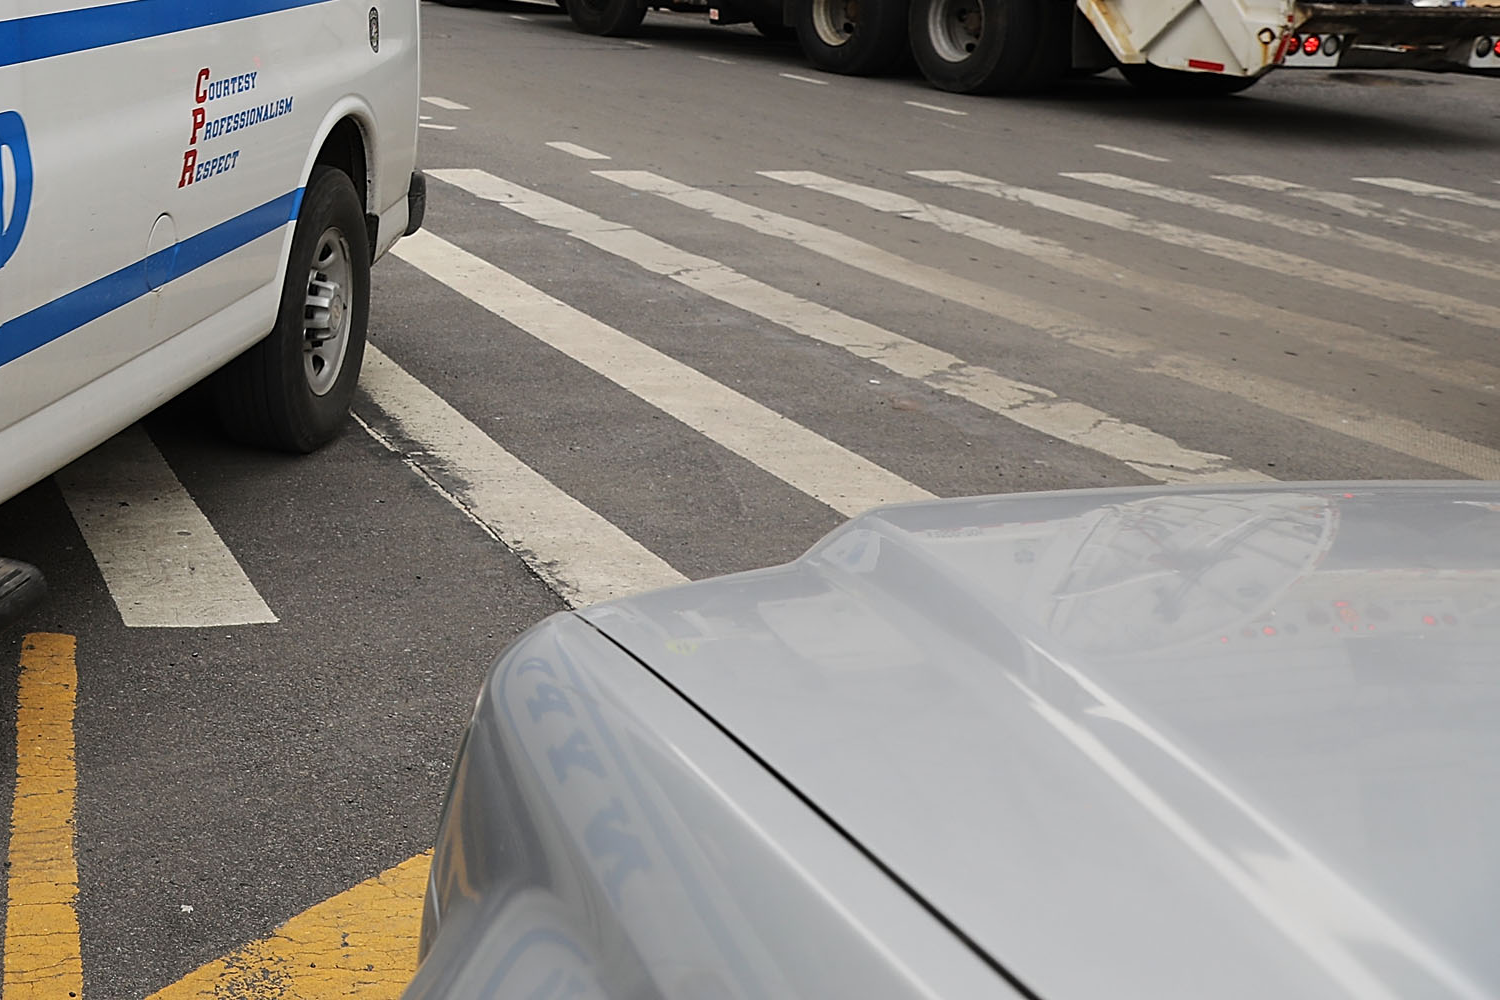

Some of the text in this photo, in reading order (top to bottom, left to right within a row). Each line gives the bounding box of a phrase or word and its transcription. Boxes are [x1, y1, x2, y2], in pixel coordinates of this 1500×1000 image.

[195, 67, 257, 104] COURTESY
[189, 96, 294, 145] PROFESSIONALISM
[178, 149, 240, 188] RESPECT
